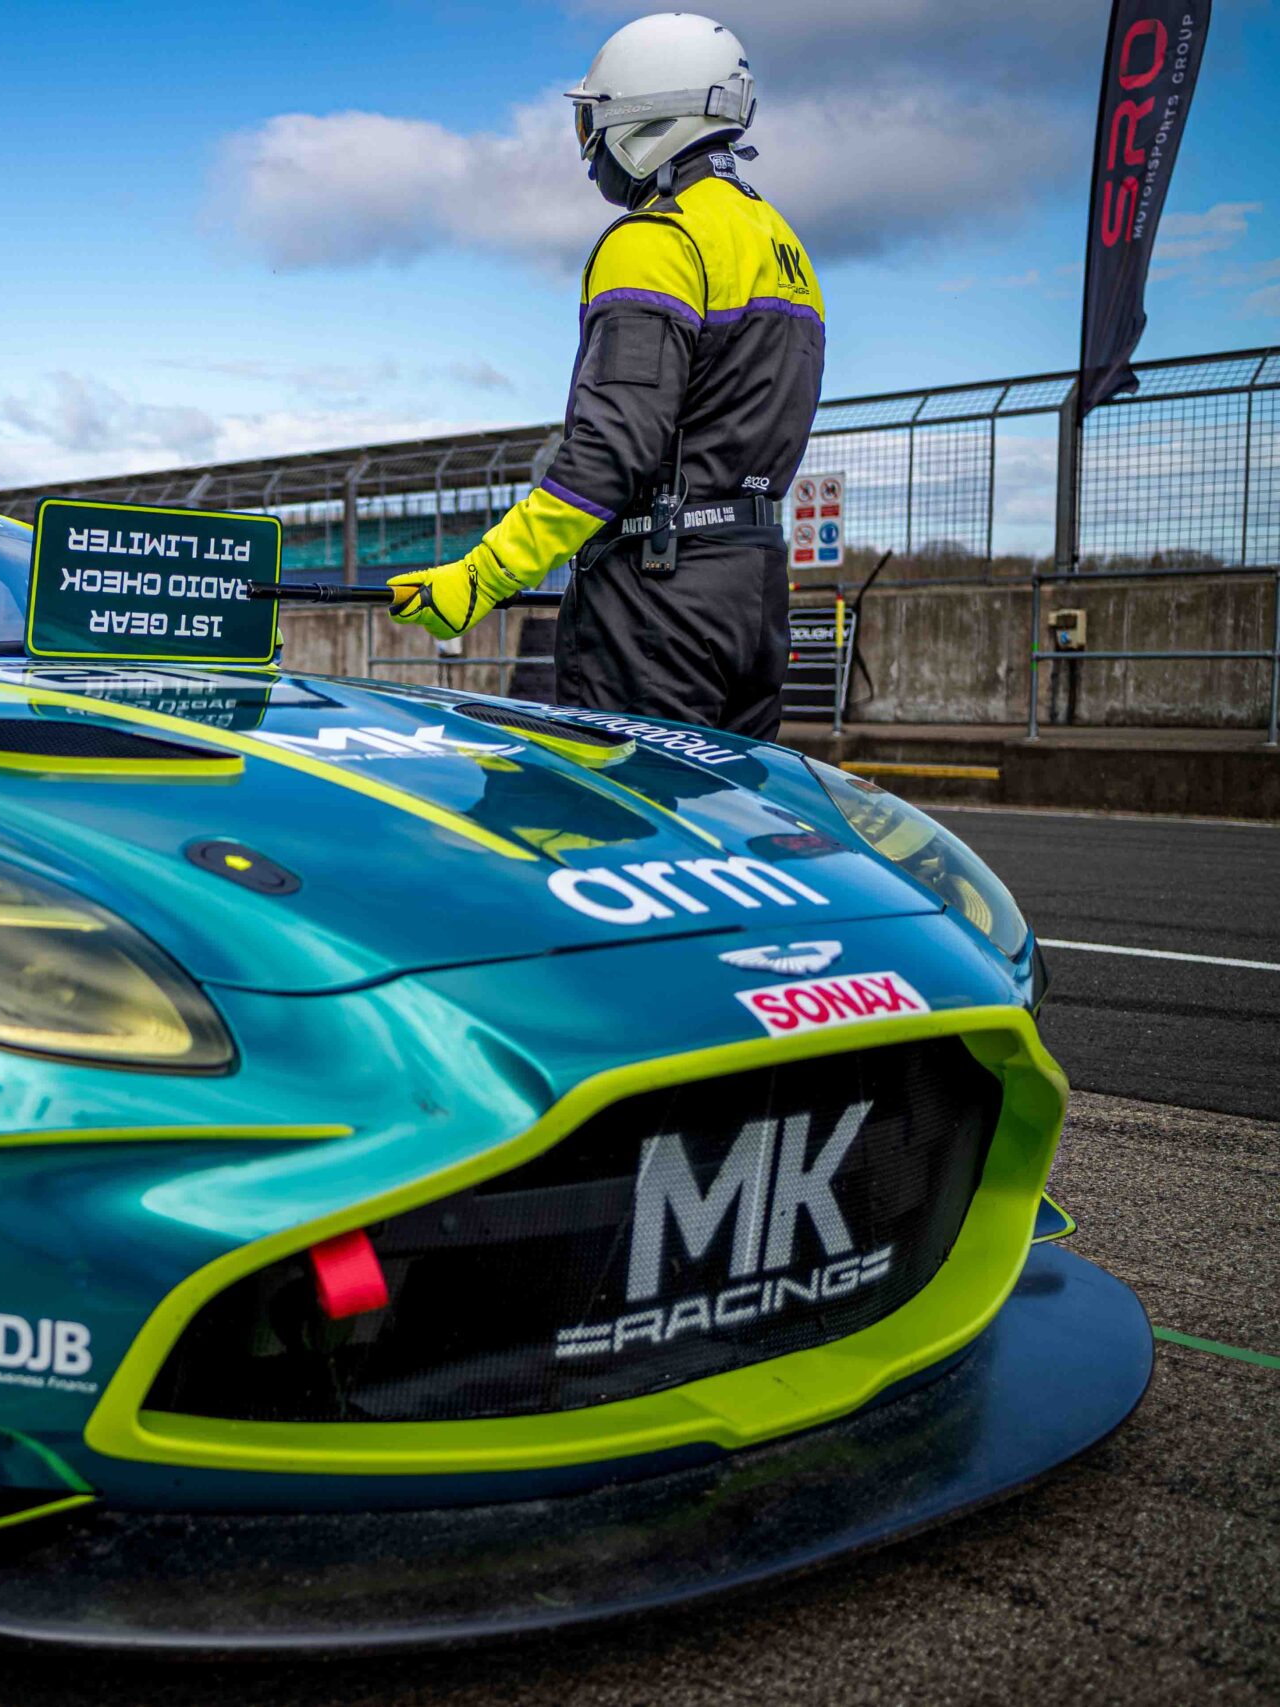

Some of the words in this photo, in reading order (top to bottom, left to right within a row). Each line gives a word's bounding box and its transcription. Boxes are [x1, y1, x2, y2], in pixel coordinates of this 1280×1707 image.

[1101, 19, 1169, 248] SRO
[1133, 94, 1179, 239] MOTORSPORTS
[1172, 14, 1194, 84] GROUP
[683, 508, 724, 528] DIGITAL
[68, 527, 199, 558] LIMITER
[204, 538, 251, 562] PIT
[59, 568, 162, 595] CHECK
[169, 574, 252, 600] RADIO
[89, 610, 168, 636] GEAR
[174, 614, 223, 637] 1ST
[548, 855, 831, 925] arm
[753, 976, 920, 1031] SONAX
[626, 1099, 875, 1302] MK
[608, 1253, 867, 1355] RACING
[47, 1375, 98, 1394] Finance
